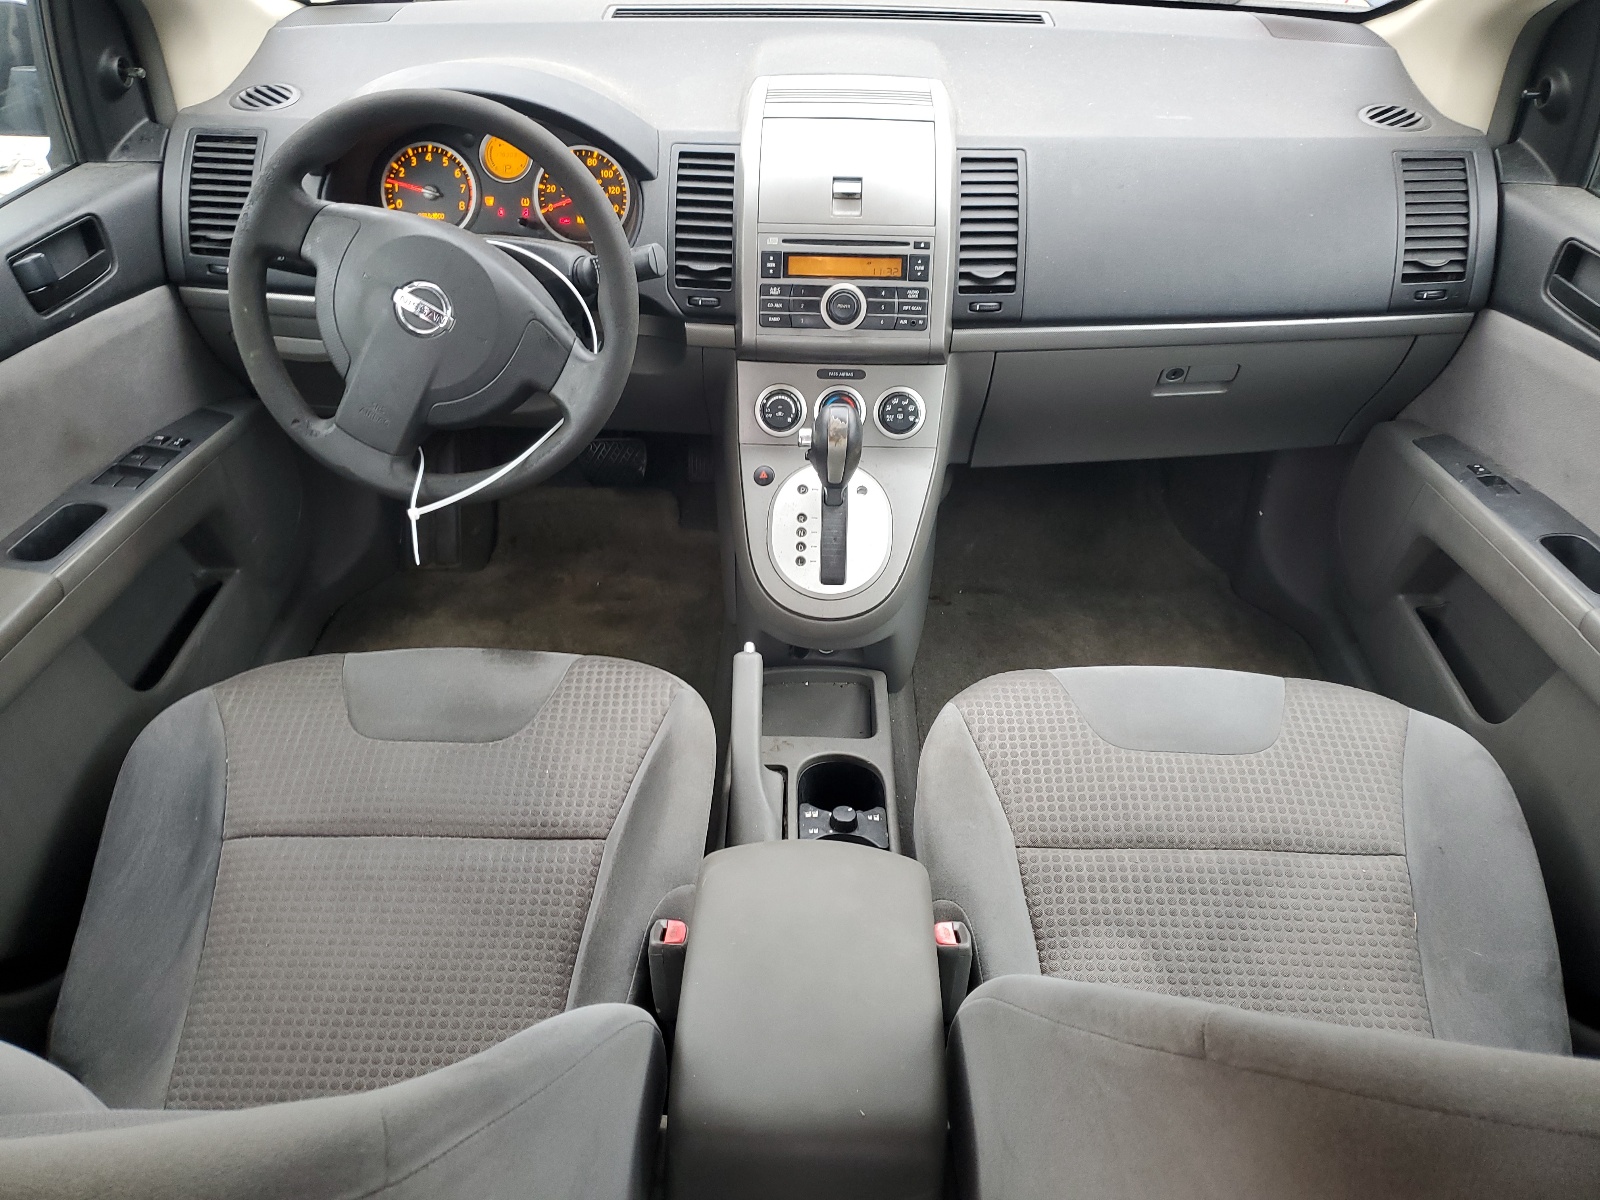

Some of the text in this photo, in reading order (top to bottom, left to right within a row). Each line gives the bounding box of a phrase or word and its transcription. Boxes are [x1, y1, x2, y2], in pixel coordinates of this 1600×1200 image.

[411, 156, 417, 167] 3
[425, 152, 432, 162] 4
[442, 156, 449, 167] 5
[587, 158, 598, 167] 80
[399, 167, 405, 178] 2
[454, 168, 461, 178] 6
[504, 165, 512, 173] P
[601, 169, 614, 178] 100
[460, 184, 466, 194] 7
[546, 184, 557, 193] 20
[608, 186, 620, 195] 120
[396, 199, 403, 209] 0
[458, 201, 466, 211] 8
[399, 295, 445, 325] NISSAN
